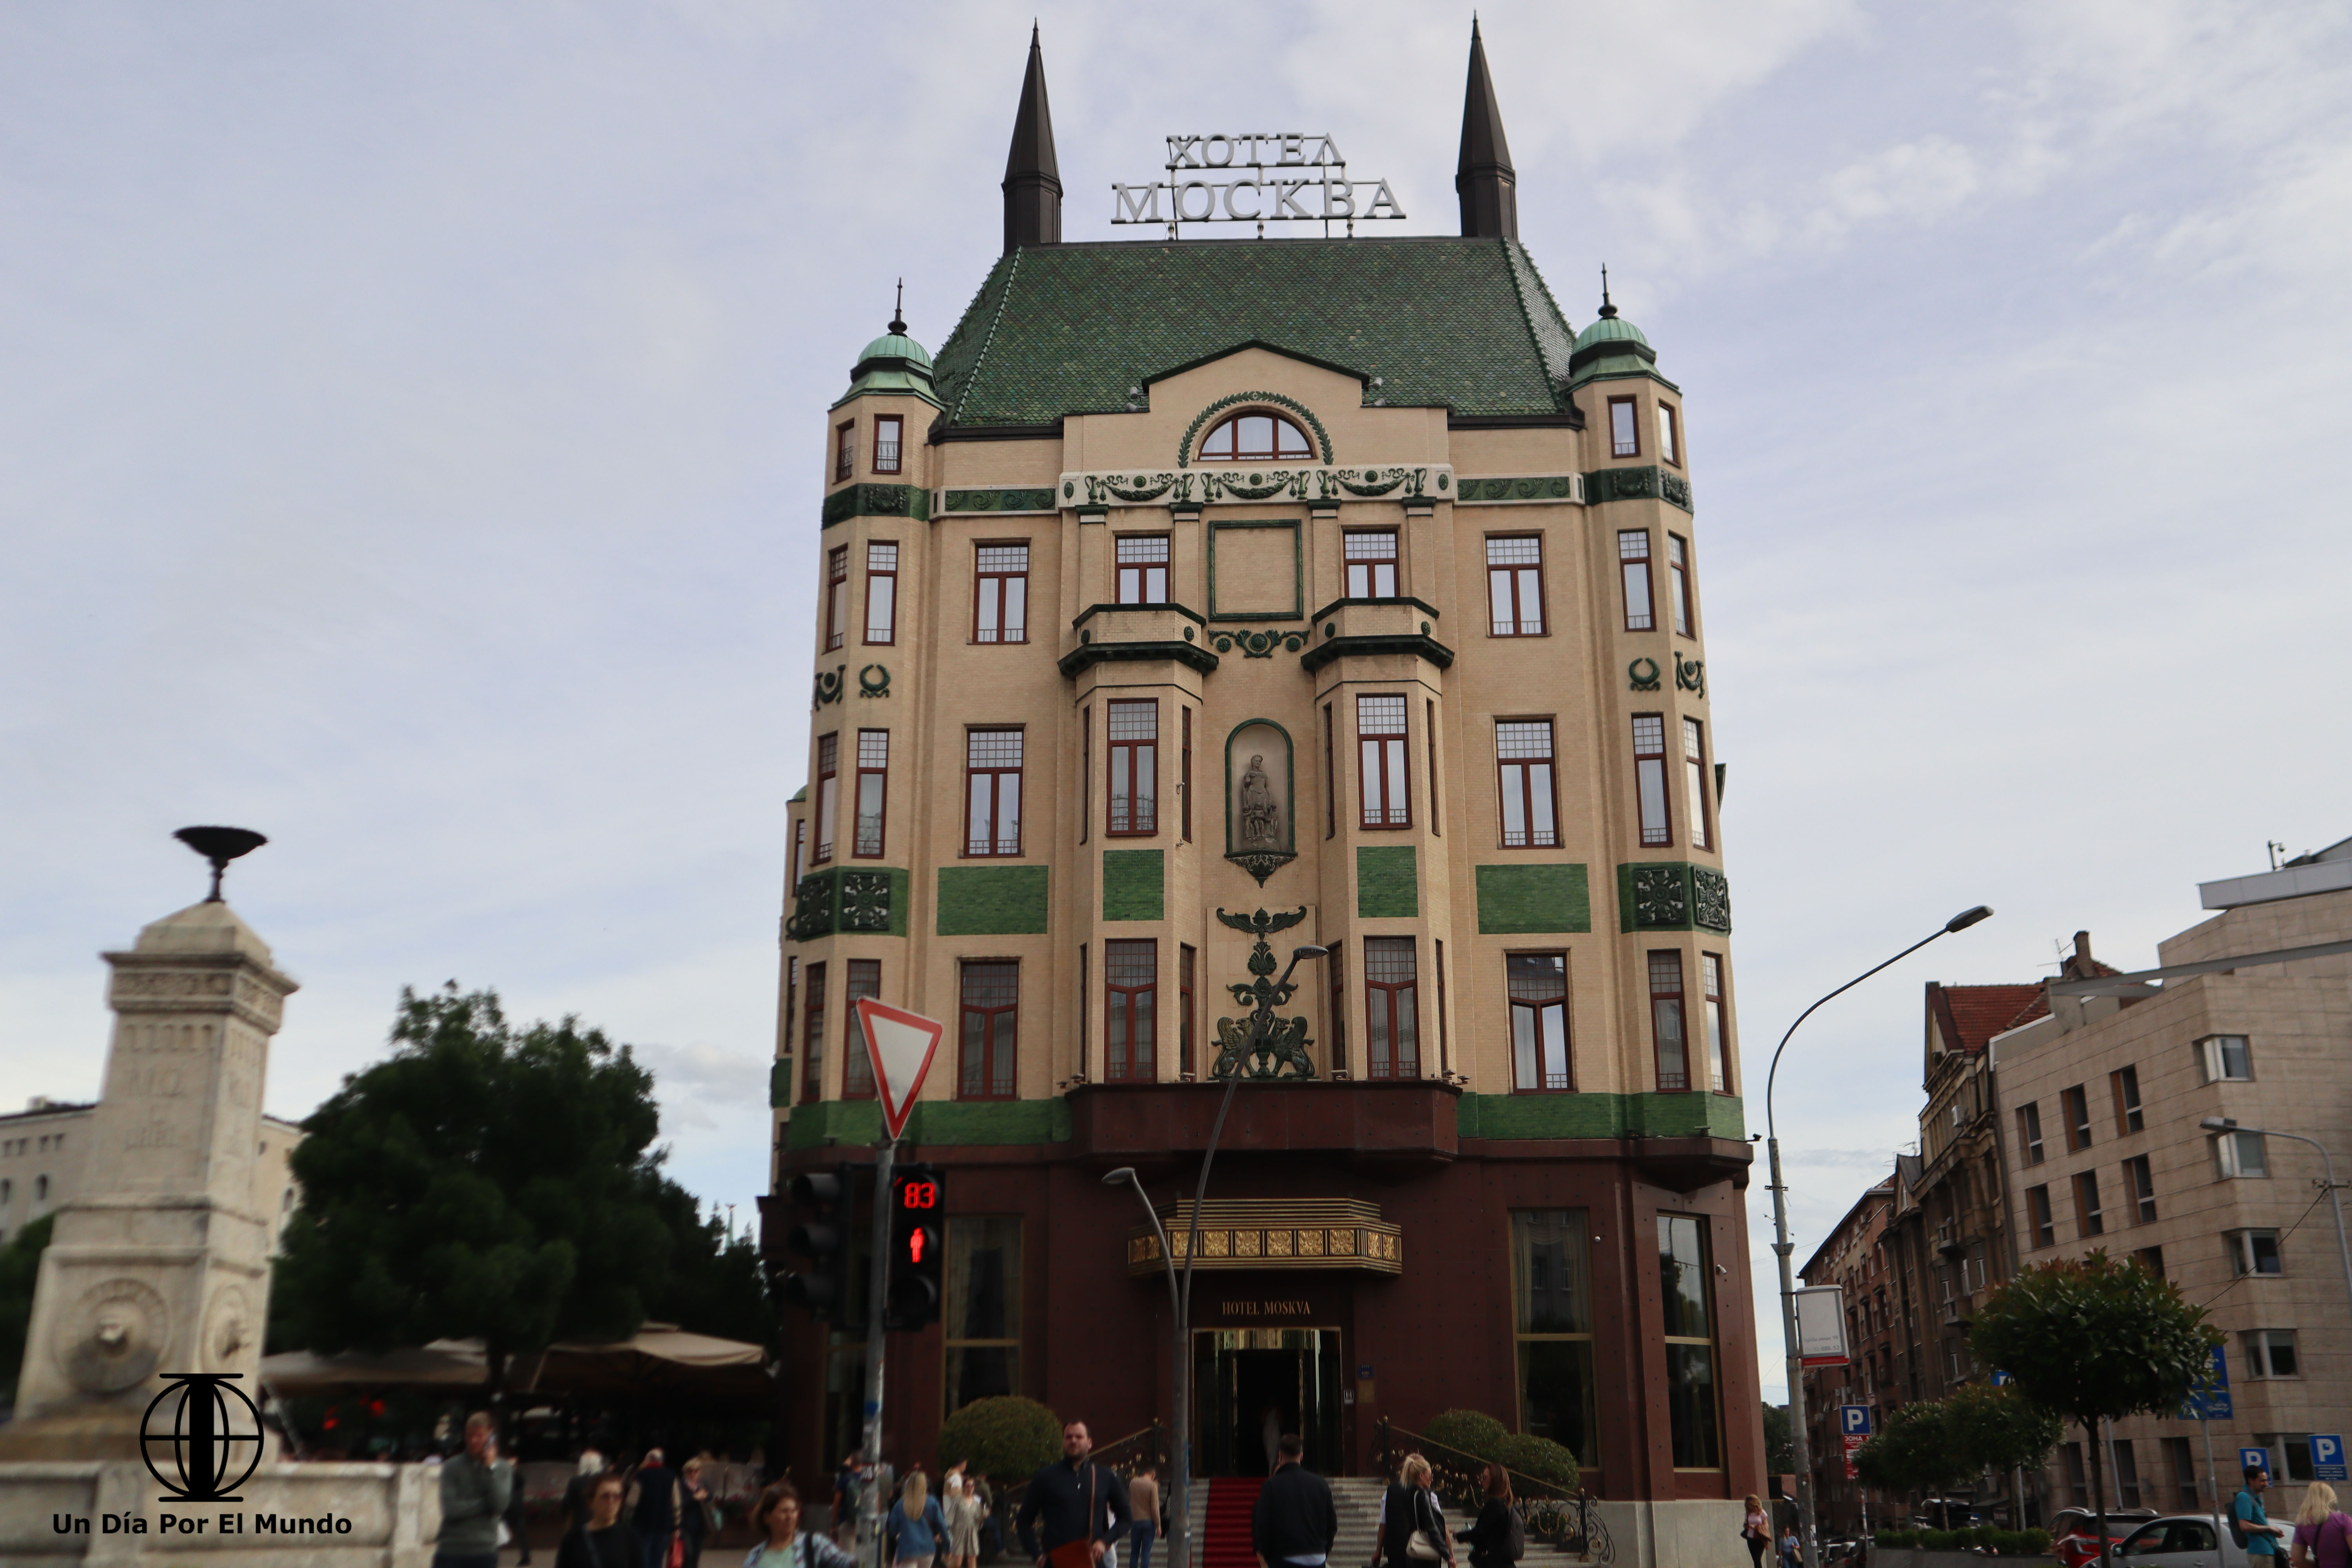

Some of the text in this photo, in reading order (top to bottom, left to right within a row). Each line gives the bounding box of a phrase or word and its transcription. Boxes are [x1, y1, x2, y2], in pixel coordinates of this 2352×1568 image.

[1165, 132, 1346, 169] ХОТЕЛ
[1111, 177, 1406, 224] МОСКВА
[904, 1182, 935, 1208] 83
[1222, 1301, 1311, 1315] HOTEL MOSKVA
[1847, 1409, 1864, 1431] P
[2316, 1438, 2336, 1462] P
